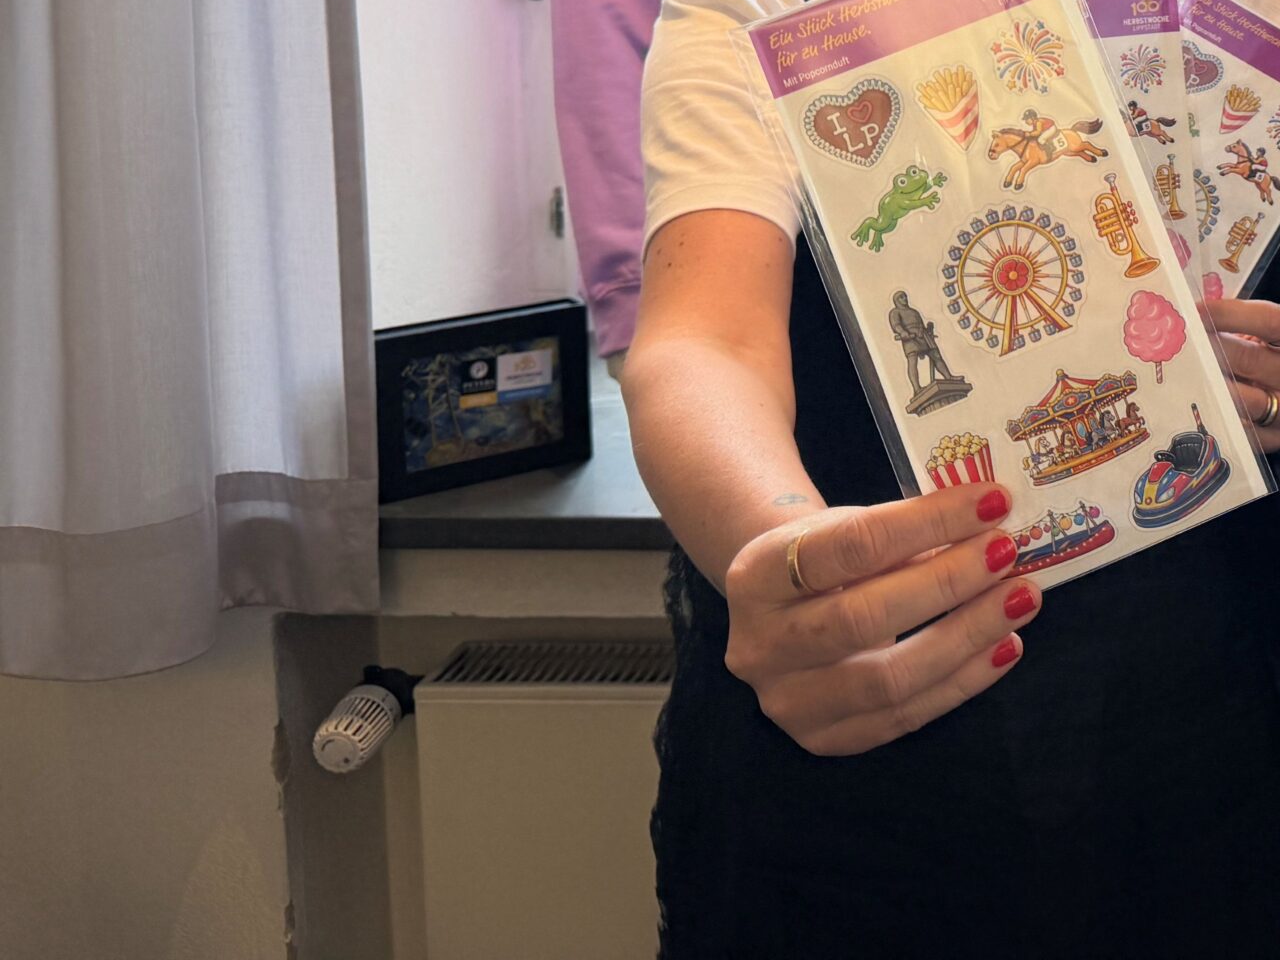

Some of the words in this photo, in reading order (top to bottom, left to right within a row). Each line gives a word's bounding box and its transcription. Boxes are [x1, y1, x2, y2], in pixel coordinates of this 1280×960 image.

[1130, 0, 1160, 17] 100
[1213, 1, 1237, 20] Stück
[1123, 15, 1170, 26] HERBSTWOCHE
[1204, 14, 1215, 24] zu
[770, 30, 793, 50] Ein
[796, 11, 836, 39] Stück
[776, 52, 798, 74] für
[801, 44, 819, 60] zu
[821, 24, 872, 52] Hause.
[783, 76, 798, 89] Mit
[798, 55, 851, 84] Popcornduft
[827, 112, 847, 136] I
[1056, 138, 1065, 148] 5
